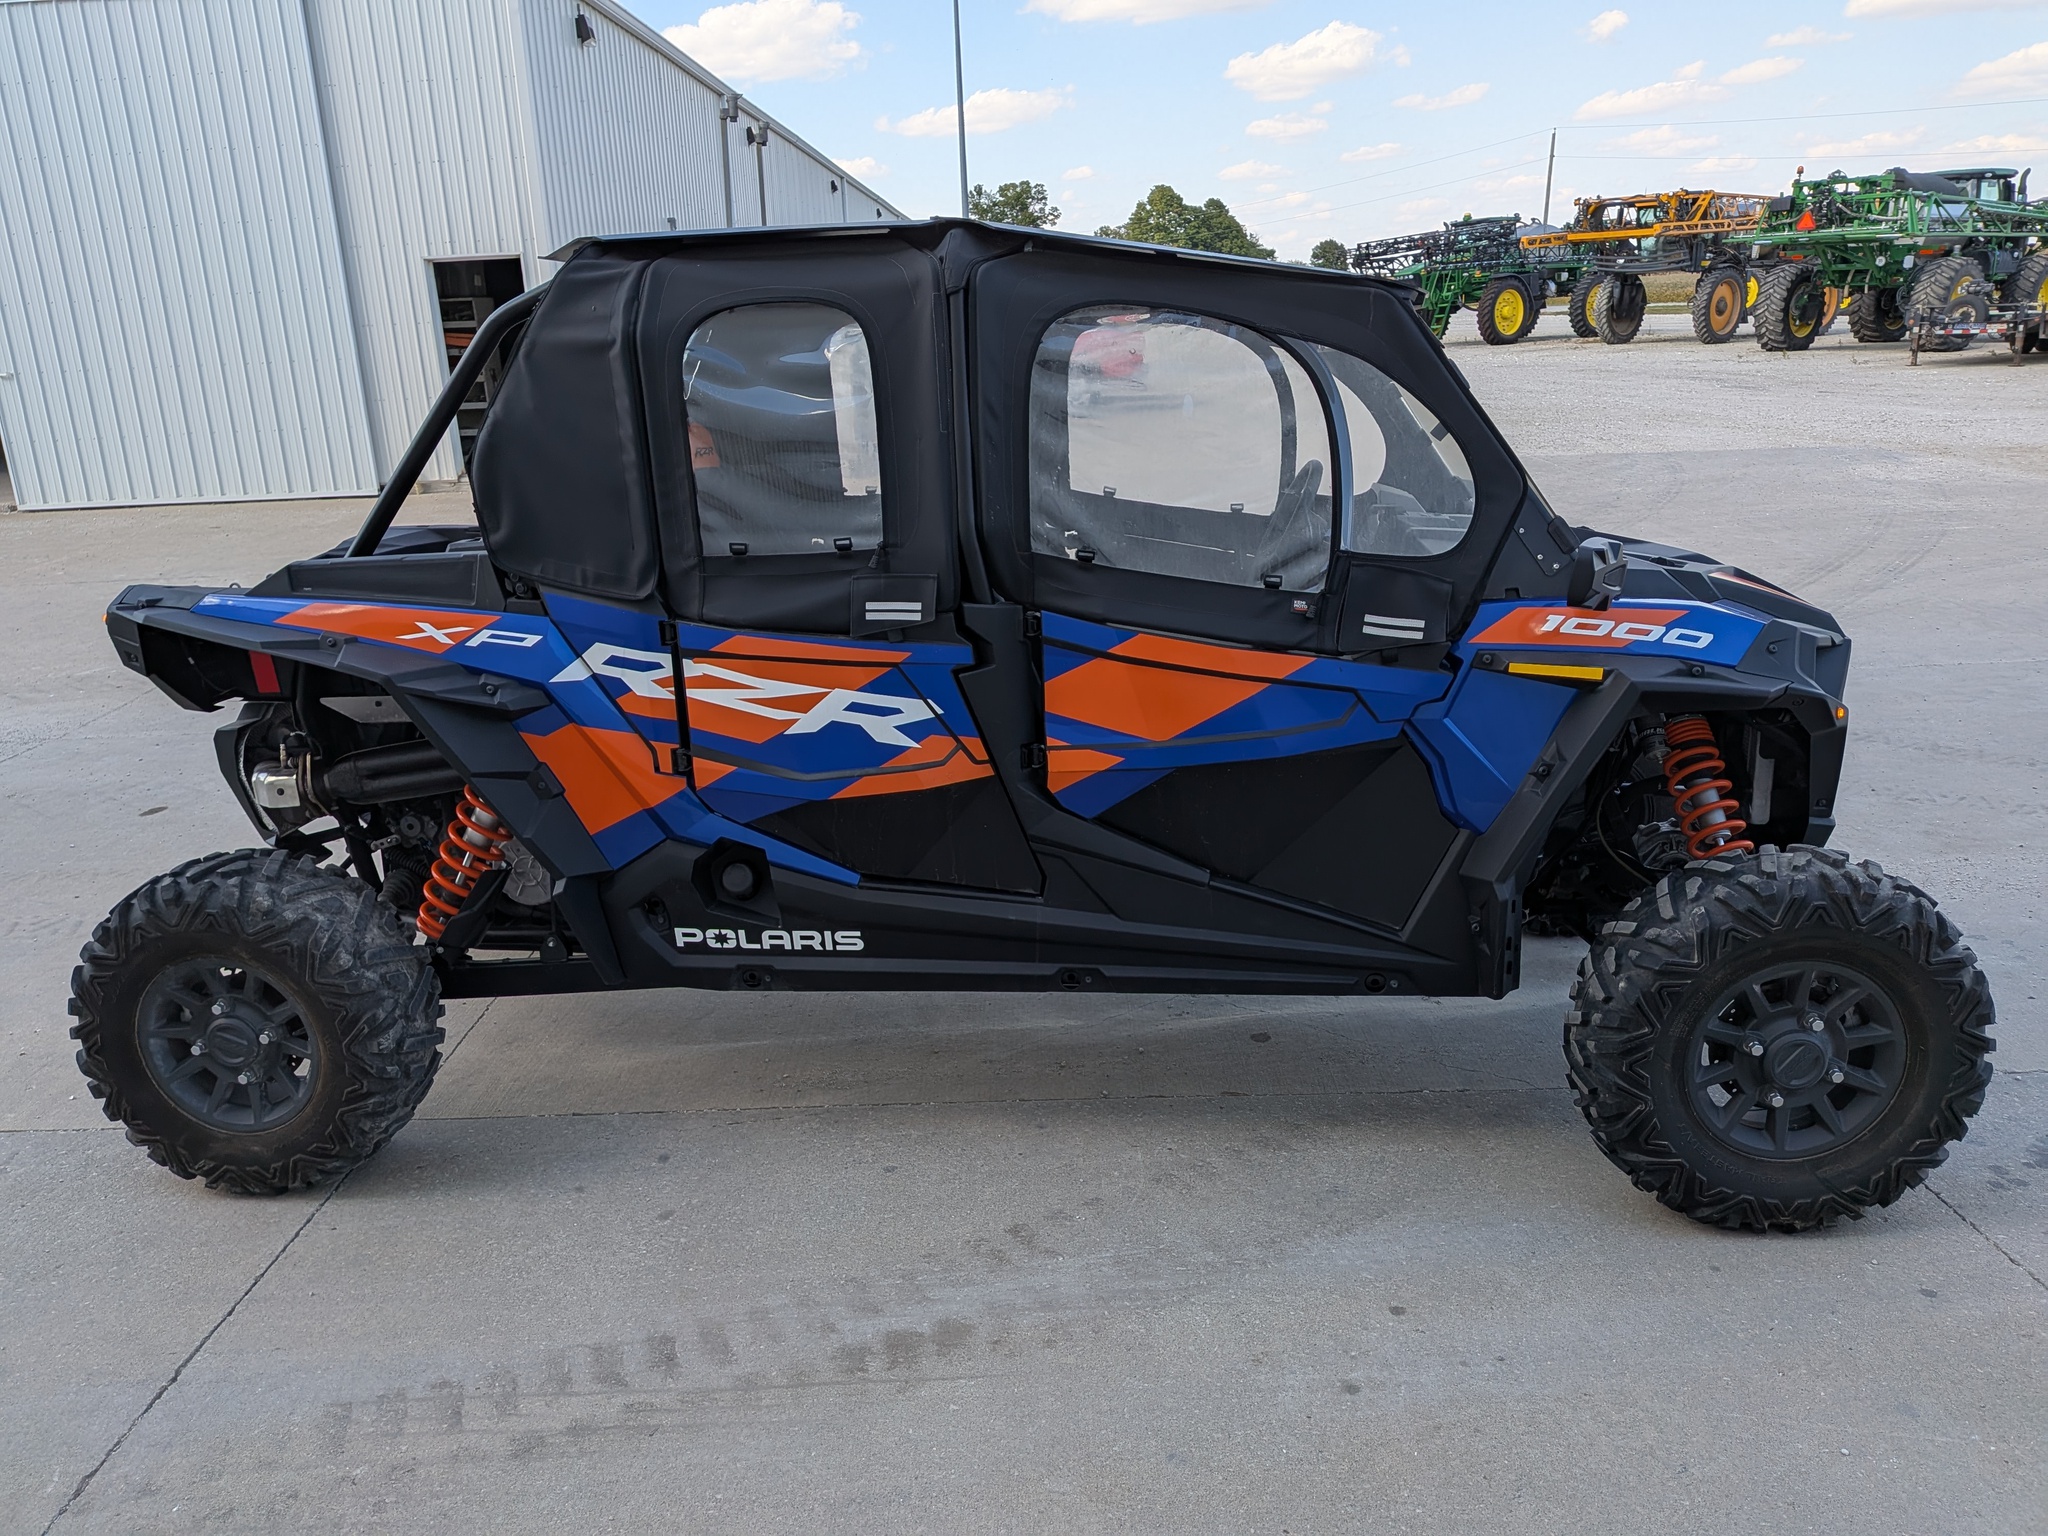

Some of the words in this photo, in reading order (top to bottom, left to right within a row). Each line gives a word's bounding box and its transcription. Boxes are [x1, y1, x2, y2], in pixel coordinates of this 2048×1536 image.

[695, 447, 714, 458] RZR
[395, 621, 543, 647] XP
[1540, 614, 1714, 649] 1000
[549, 642, 944, 748] RZR
[674, 927, 865, 951] POLARIS
